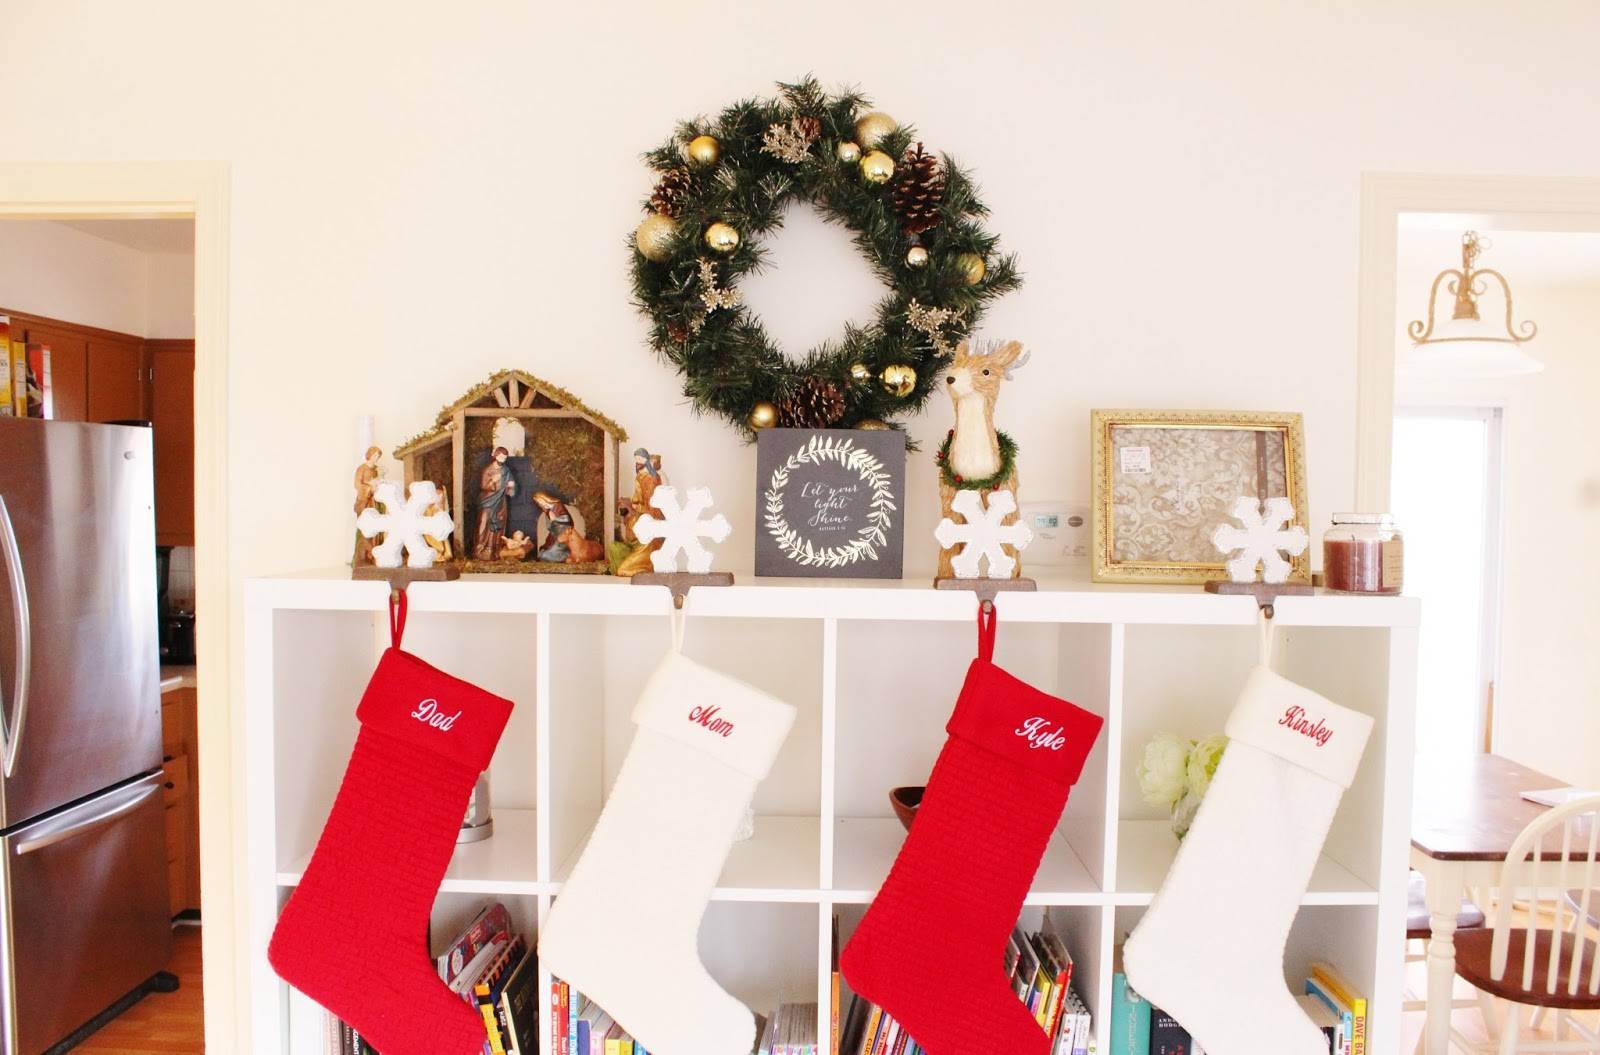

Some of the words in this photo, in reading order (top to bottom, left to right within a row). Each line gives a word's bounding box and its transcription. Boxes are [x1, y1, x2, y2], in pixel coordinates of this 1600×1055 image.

[801, 481, 829, 497] Let
[828, 484, 857, 501] your
[814, 496, 852, 513] light
[411, 698, 462, 731] Dad
[688, 704, 735, 737] Mom
[1278, 705, 1334, 747] Kinsley
[1014, 716, 1066, 751] Kyle
[1355, 1016, 1364, 1039] DAVE
